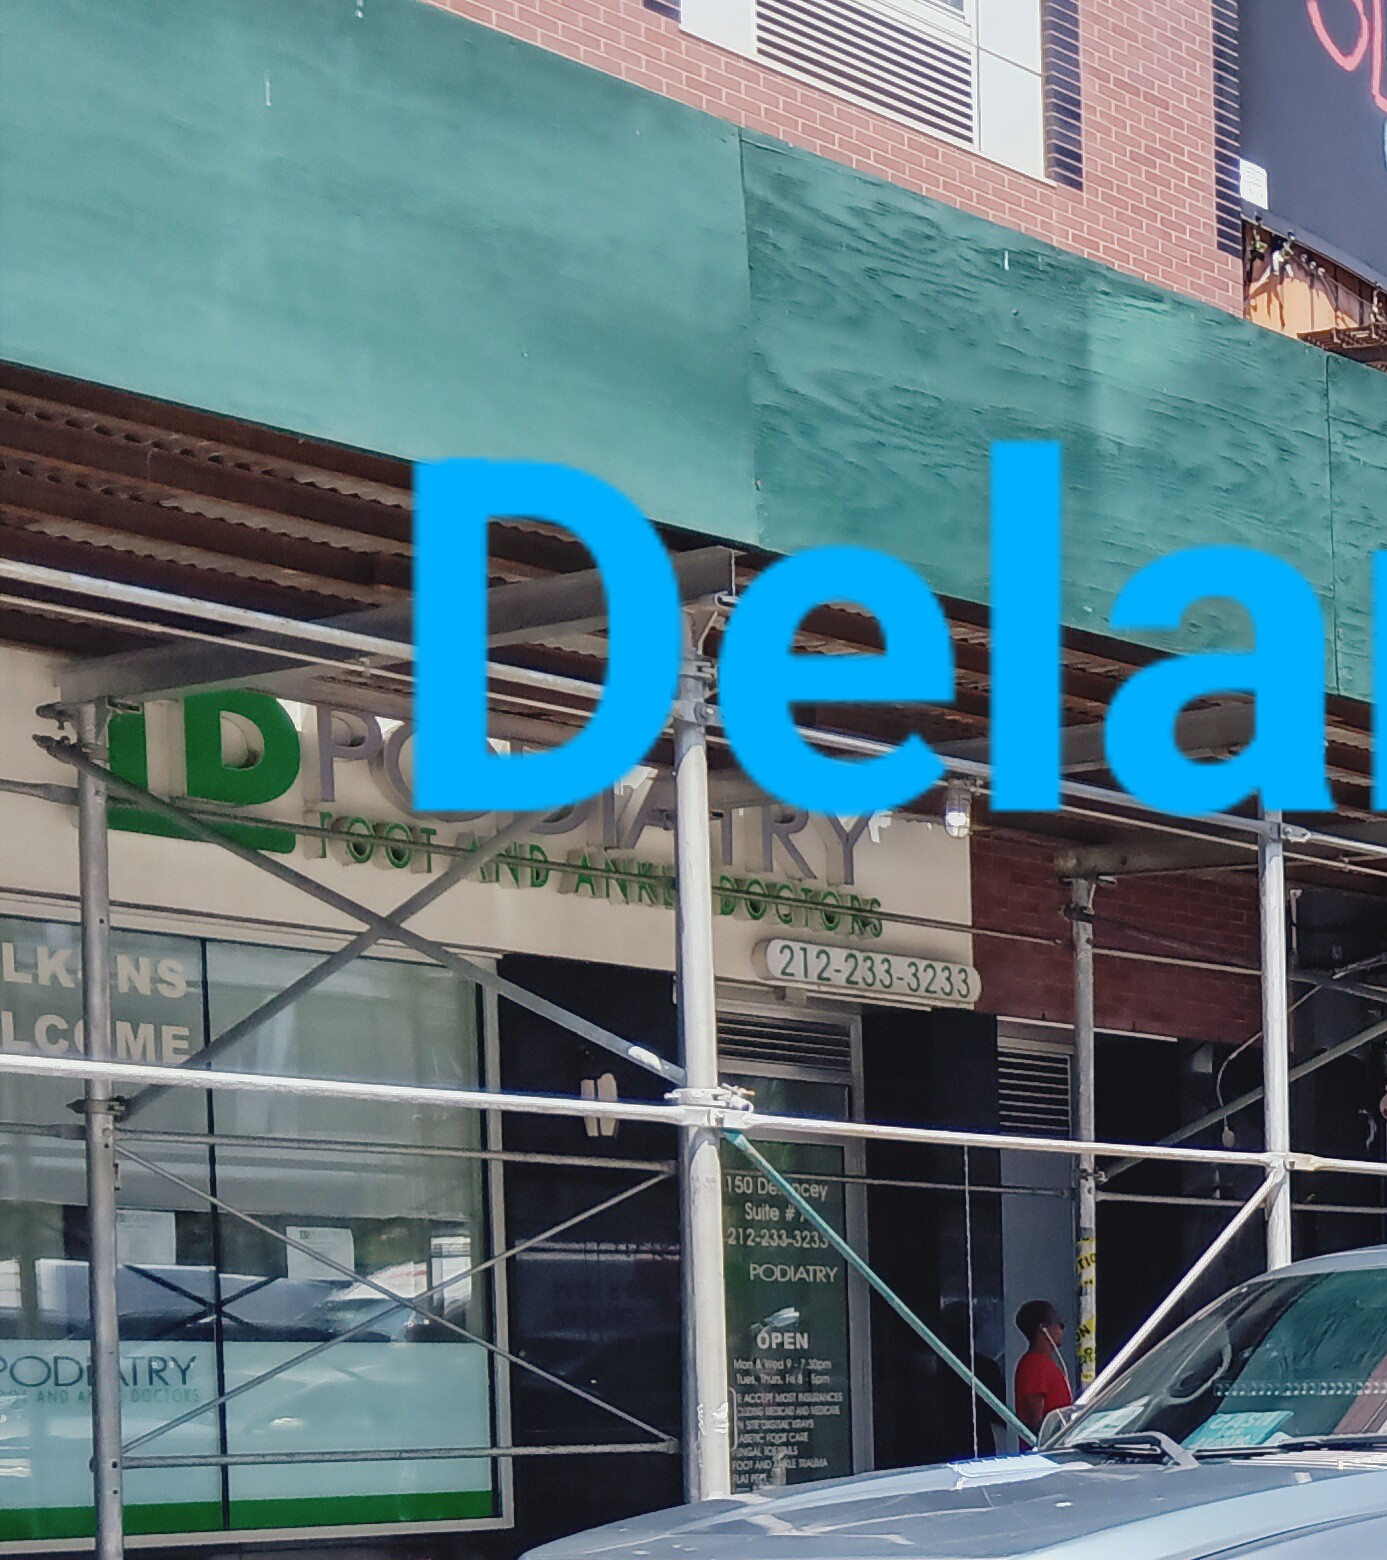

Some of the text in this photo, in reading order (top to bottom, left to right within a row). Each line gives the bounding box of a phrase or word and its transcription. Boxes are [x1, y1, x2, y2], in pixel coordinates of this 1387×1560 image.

[319, 811, 437, 873] FOOT
[574, 852, 677, 908] ANKL
[719, 874, 883, 938] DOCTORS
[779, 943, 971, 999] 212-233-3233
[726, 1175, 753, 1194] 150
[744, 1202, 780, 1221] Suite
[750, 1263, 838, 1283] PODIATRY
[756, 1332, 809, 1350] OPEN
